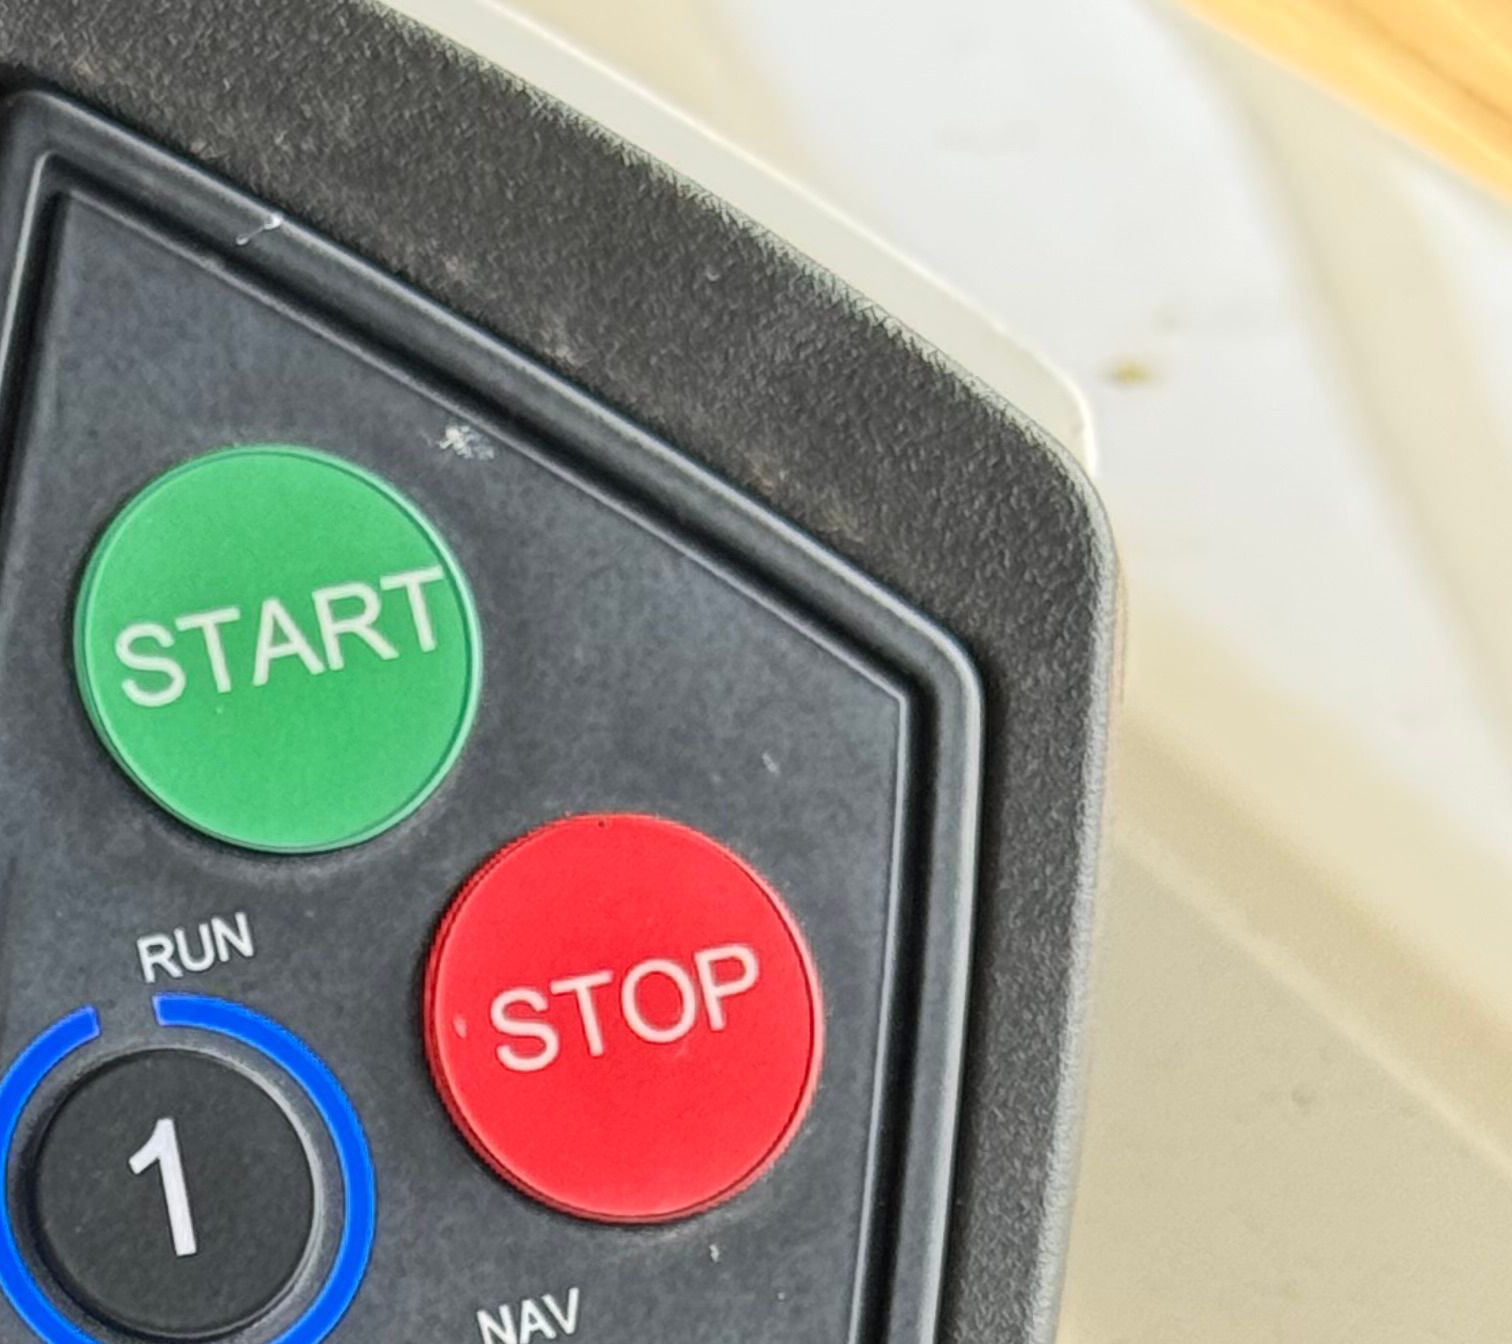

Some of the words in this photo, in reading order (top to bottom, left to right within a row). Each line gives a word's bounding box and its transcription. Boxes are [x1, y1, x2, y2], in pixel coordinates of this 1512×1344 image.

[115, 566, 445, 707] START
[136, 911, 255, 983] RUN
[490, 942, 761, 1072] STOP
[128, 1117, 197, 1257] 1
